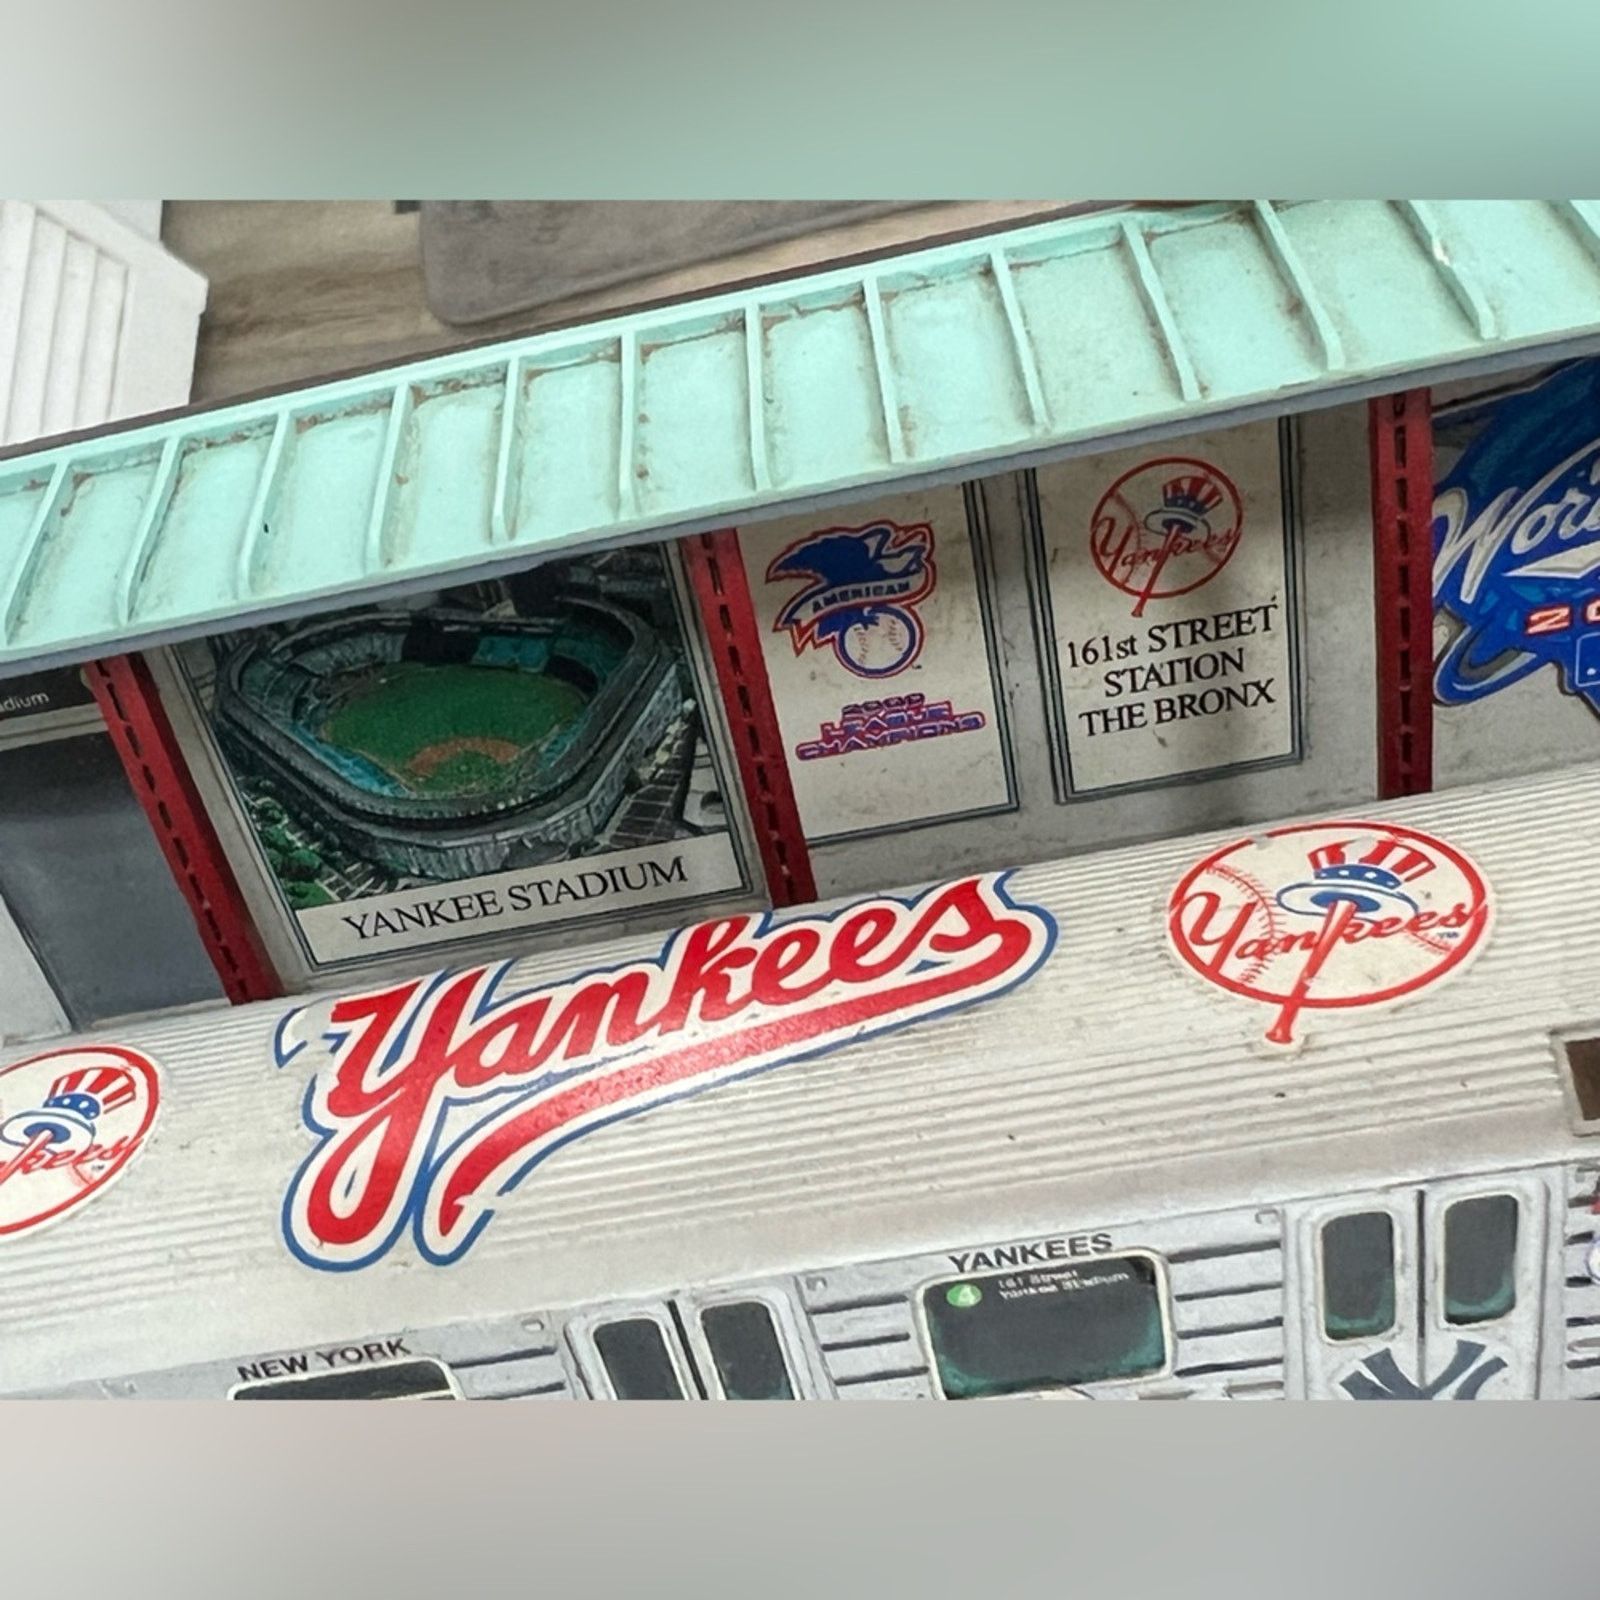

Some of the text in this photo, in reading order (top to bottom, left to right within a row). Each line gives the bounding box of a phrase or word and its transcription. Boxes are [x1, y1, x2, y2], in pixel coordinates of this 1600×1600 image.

[1090, 515, 1241, 578] Yankees
[811, 580, 911, 613] AMERICAN
[1067, 602, 1278, 668] 161st STREET
[1103, 646, 1245, 698] STATION
[0, 693, 50, 711] dium
[1078, 677, 1277, 737] THE BRONX
[342, 855, 689, 940] YANKEE STADIUM
[1170, 891, 1488, 975] Yankees
[305, 872, 1036, 1248] Yankees
[0, 1135, 144, 1175] kees
[948, 1233, 1113, 1273] YANKEES
[237, 1338, 412, 1381] NEW YORK
